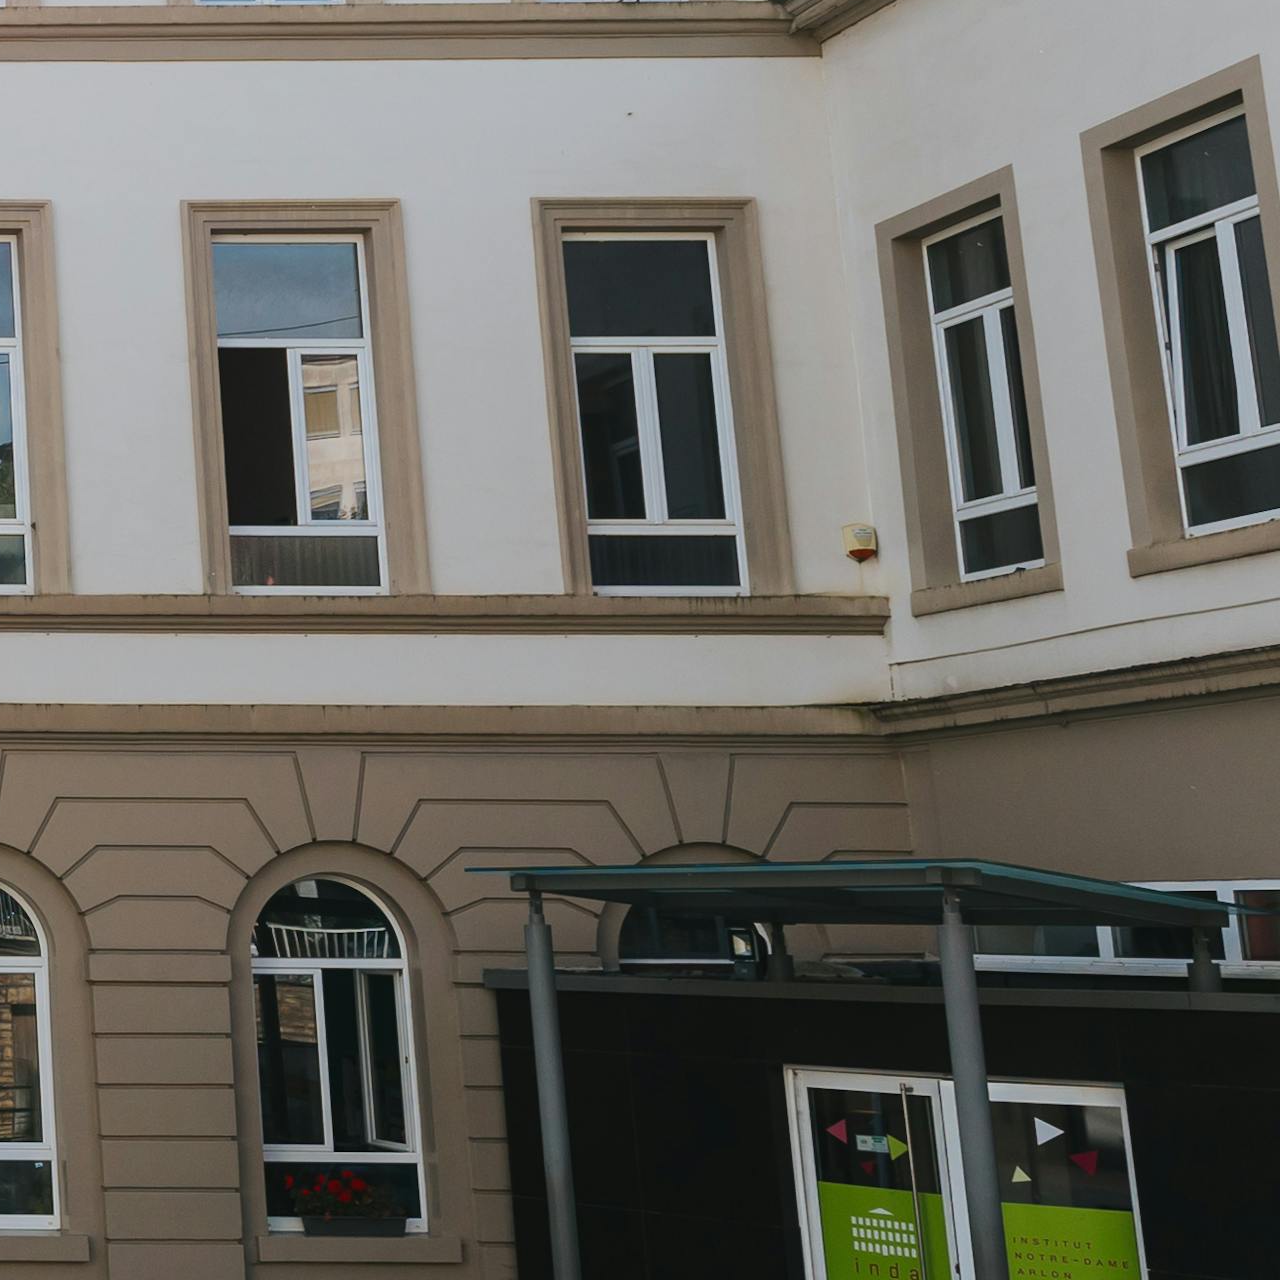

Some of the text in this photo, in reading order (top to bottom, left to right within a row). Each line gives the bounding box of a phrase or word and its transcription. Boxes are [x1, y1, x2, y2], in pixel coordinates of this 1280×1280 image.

[1012, 1236, 1092, 1250] INSTITUT
[1014, 1251, 1129, 1269] NOTRE-DAME
[854, 1257, 920, 1280] inda
[1017, 1267, 1073, 1280] ARLON
